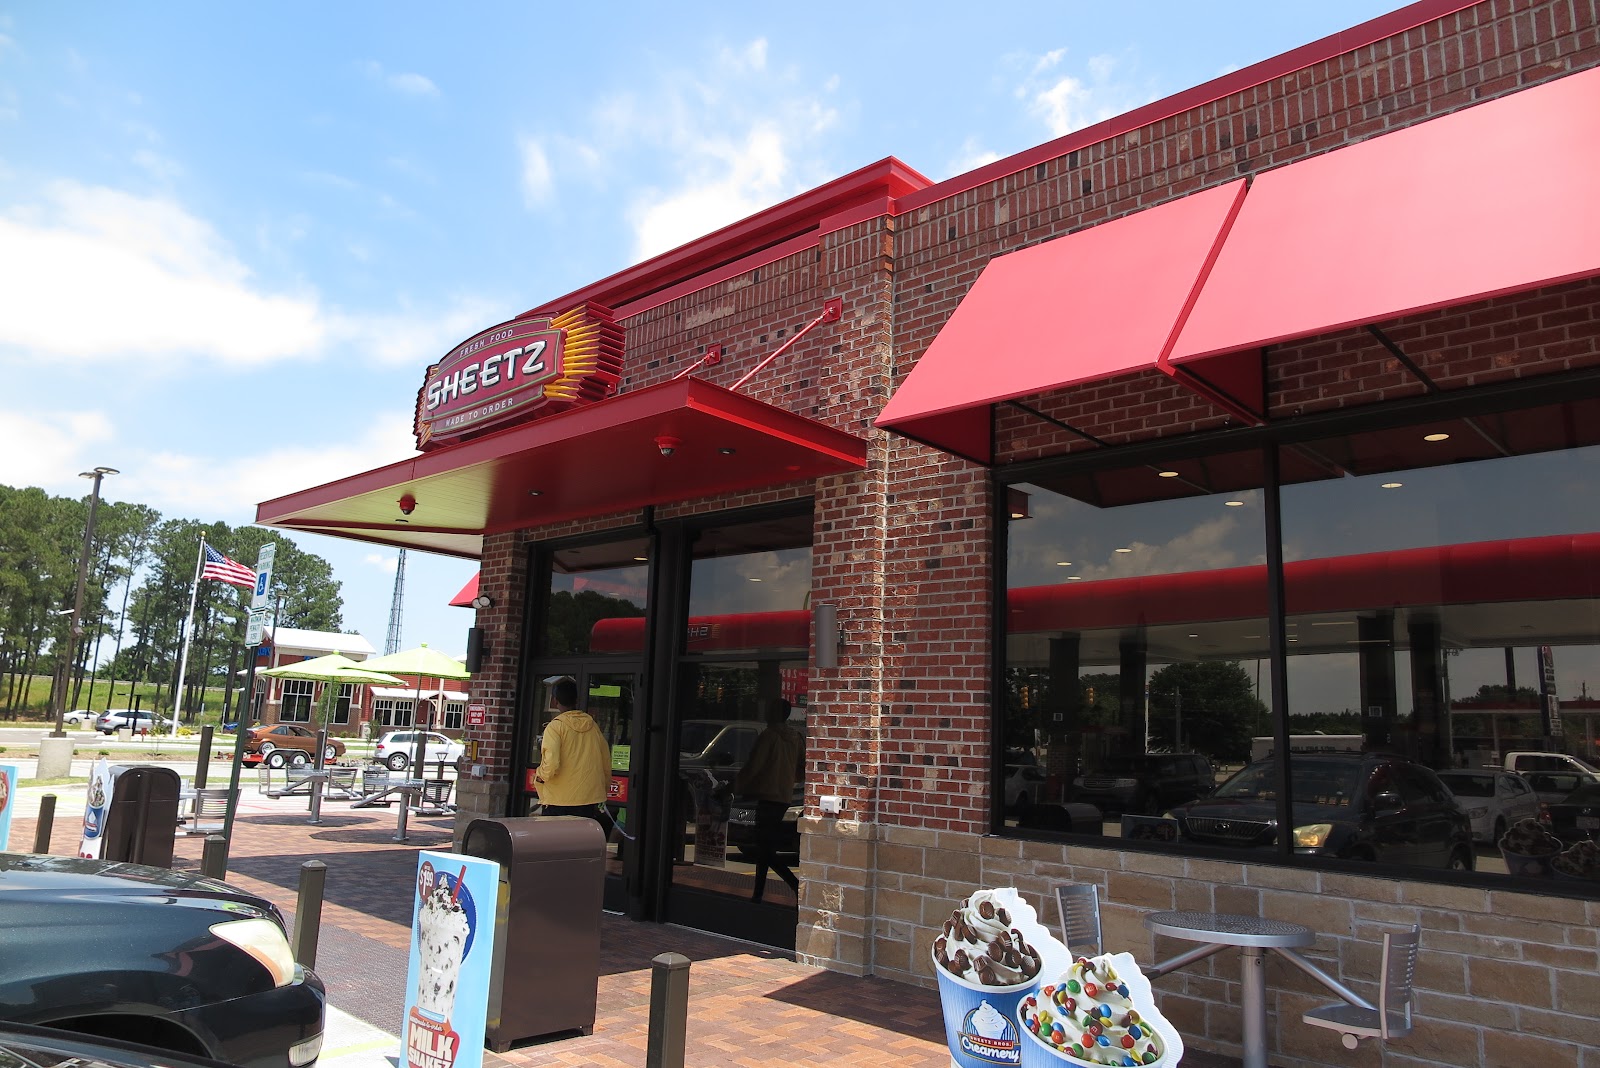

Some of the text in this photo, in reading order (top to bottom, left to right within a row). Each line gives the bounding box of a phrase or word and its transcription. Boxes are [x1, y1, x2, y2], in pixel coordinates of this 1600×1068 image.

[459, 329, 513, 358] FRESH FOOD
[427, 340, 547, 411] SHEETZ
[445, 398, 513, 427] MADE TO ORDER
[409, 1023, 455, 1062] MILK
[962, 1036, 1020, 1063] Creamery
